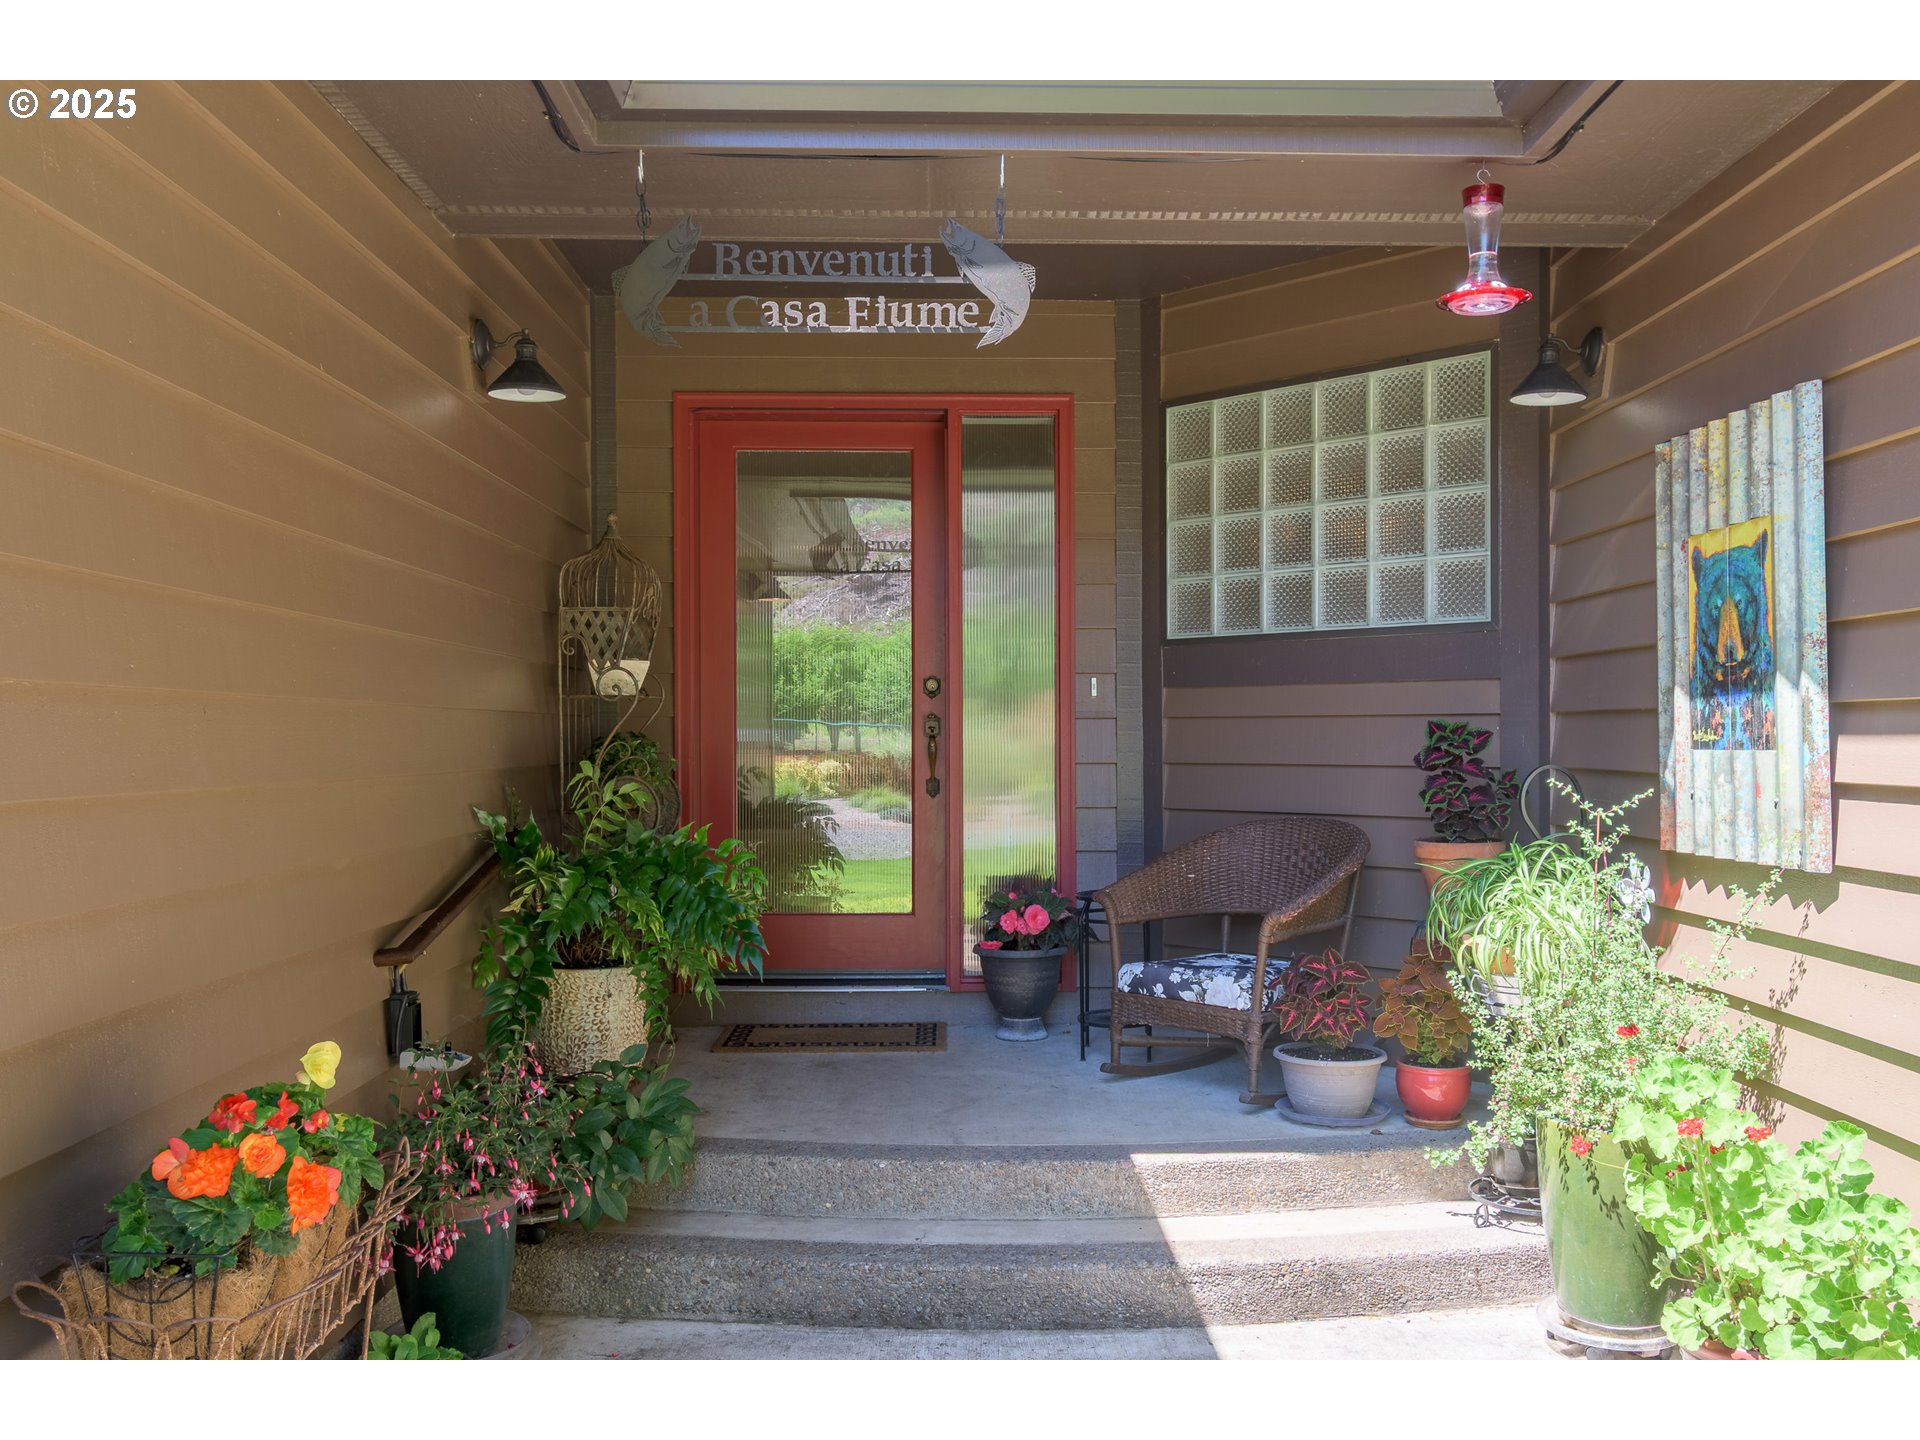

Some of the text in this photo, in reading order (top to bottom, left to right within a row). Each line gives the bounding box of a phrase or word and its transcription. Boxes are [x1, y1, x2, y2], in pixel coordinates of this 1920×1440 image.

[712, 241, 935, 279] Benvenuti
[689, 295, 980, 333] a Casa Fiume
